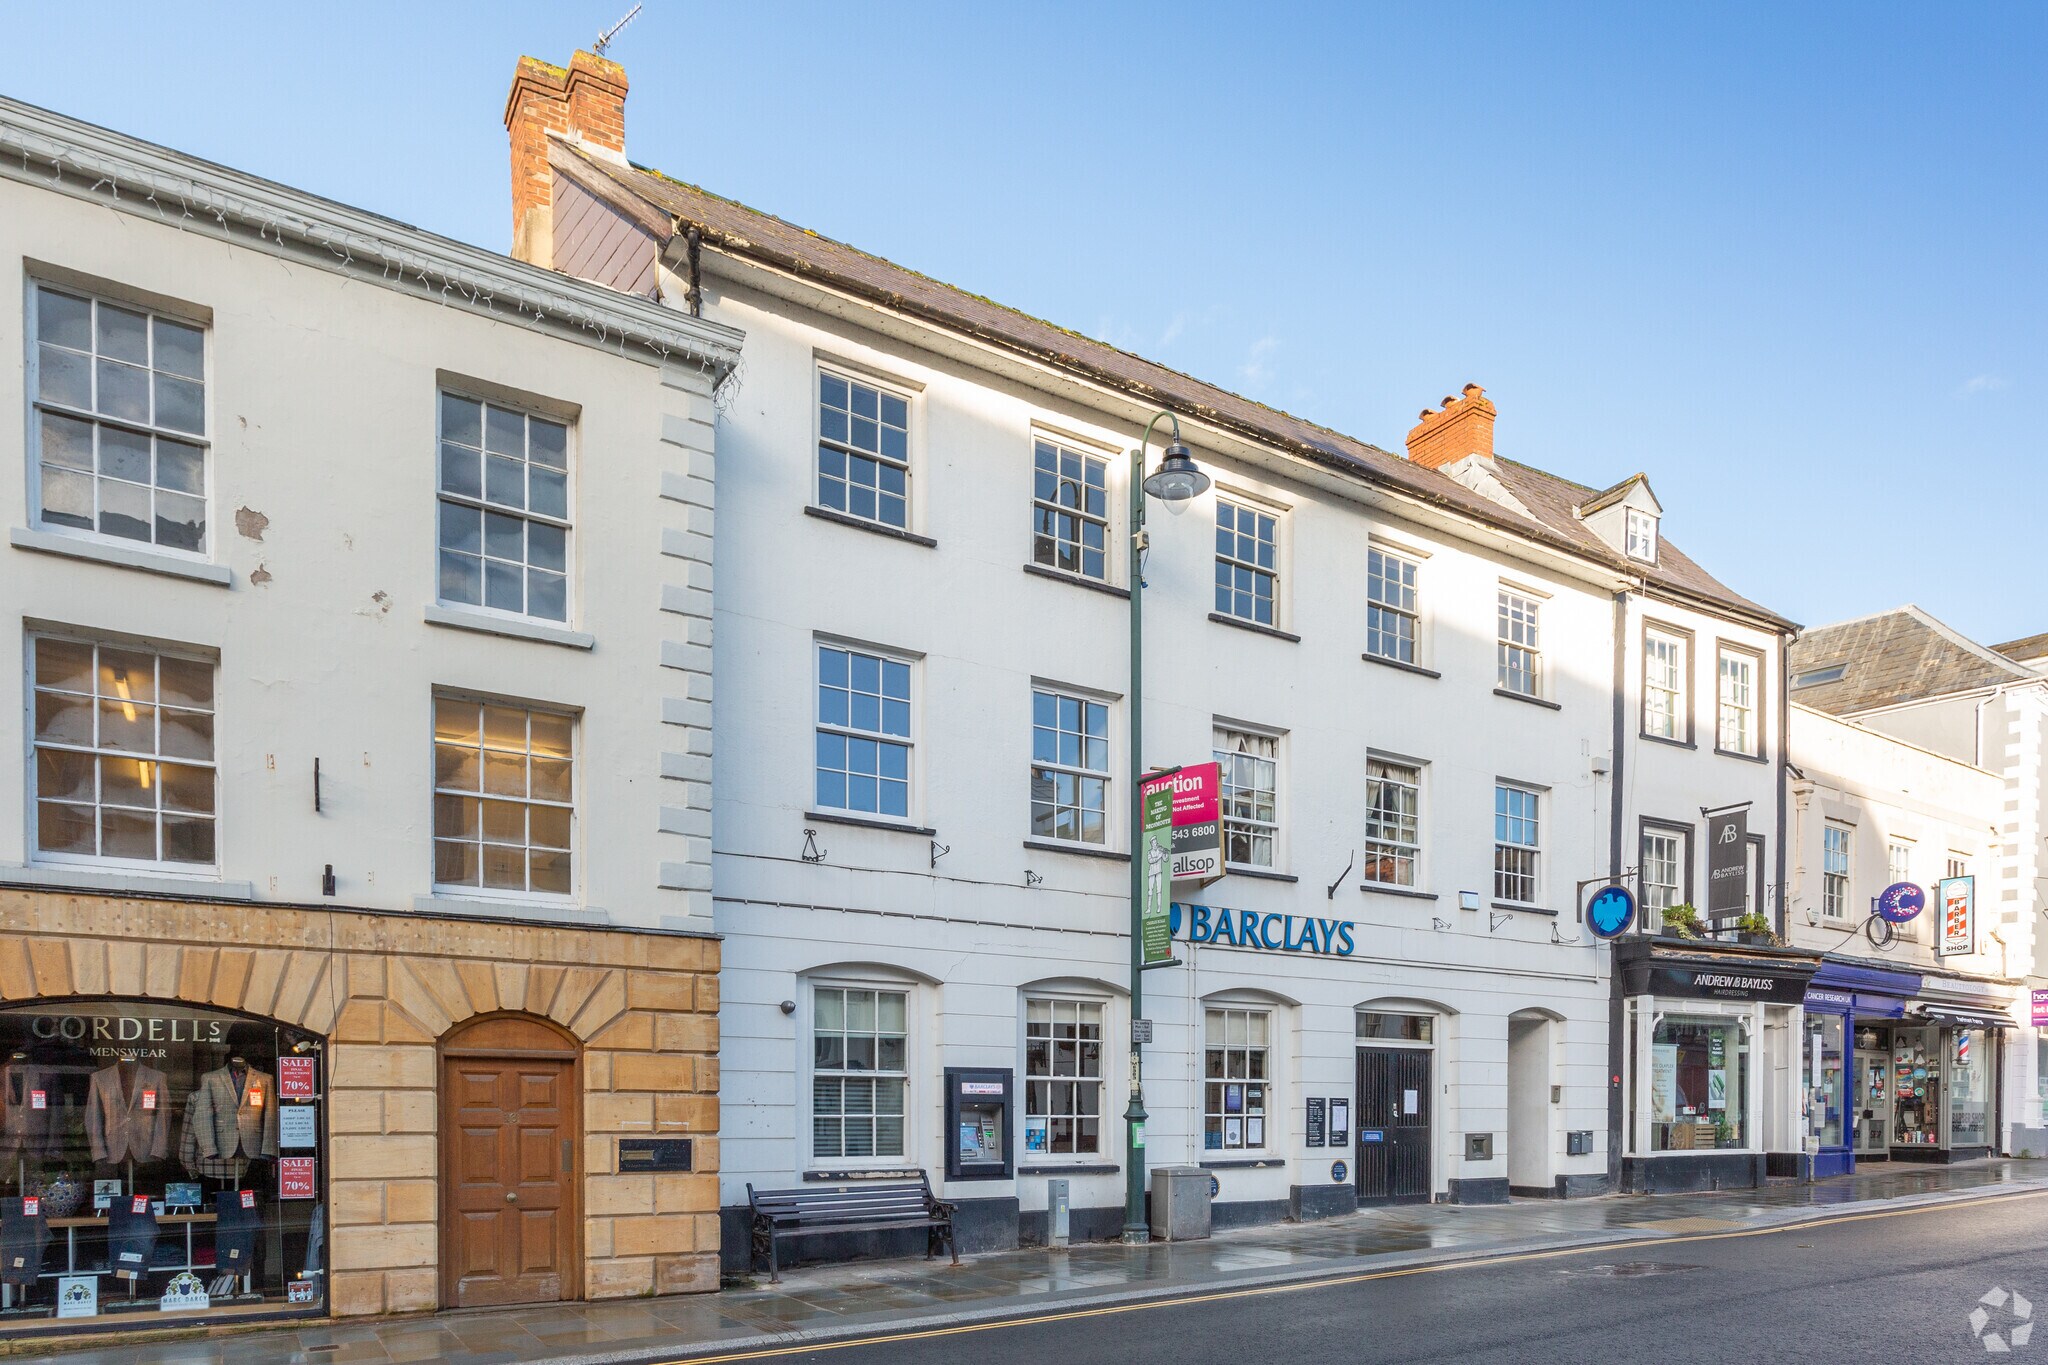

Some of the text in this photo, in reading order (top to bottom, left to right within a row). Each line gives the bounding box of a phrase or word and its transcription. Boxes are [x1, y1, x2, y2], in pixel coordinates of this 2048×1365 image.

[1146, 774, 1203, 796] auction
[1172, 795, 1200, 804] nvestment
[1183, 802, 1205, 811] Affected
[1172, 825, 1216, 840] 543 6800
[1173, 856, 1215, 873] allsop
[1721, 865, 1745, 873] ANDREW
[1720, 870, 1745, 879] BAYLISS
[1190, 904, 1355, 956] BARCLAYS
[1694, 974, 1733, 987] ANDREW
[1741, 977, 1774, 990] BAYLISS
[1713, 989, 1749, 997] HAIRDRESSING
[1807, 992, 1824, 1001] CANCER
[1824, 993, 1844, 1002] RESEARCH
[2032, 1005, 2046, 1014] let
[32, 1015, 221, 1042] CORDELLS
[89, 1047, 167, 1058] MENSWEAR
[282, 1059, 311, 1067] SALE
[284, 1081, 310, 1090] 70%
[283, 1159, 311, 1167] SALE
[285, 1181, 310, 1190] 70%
